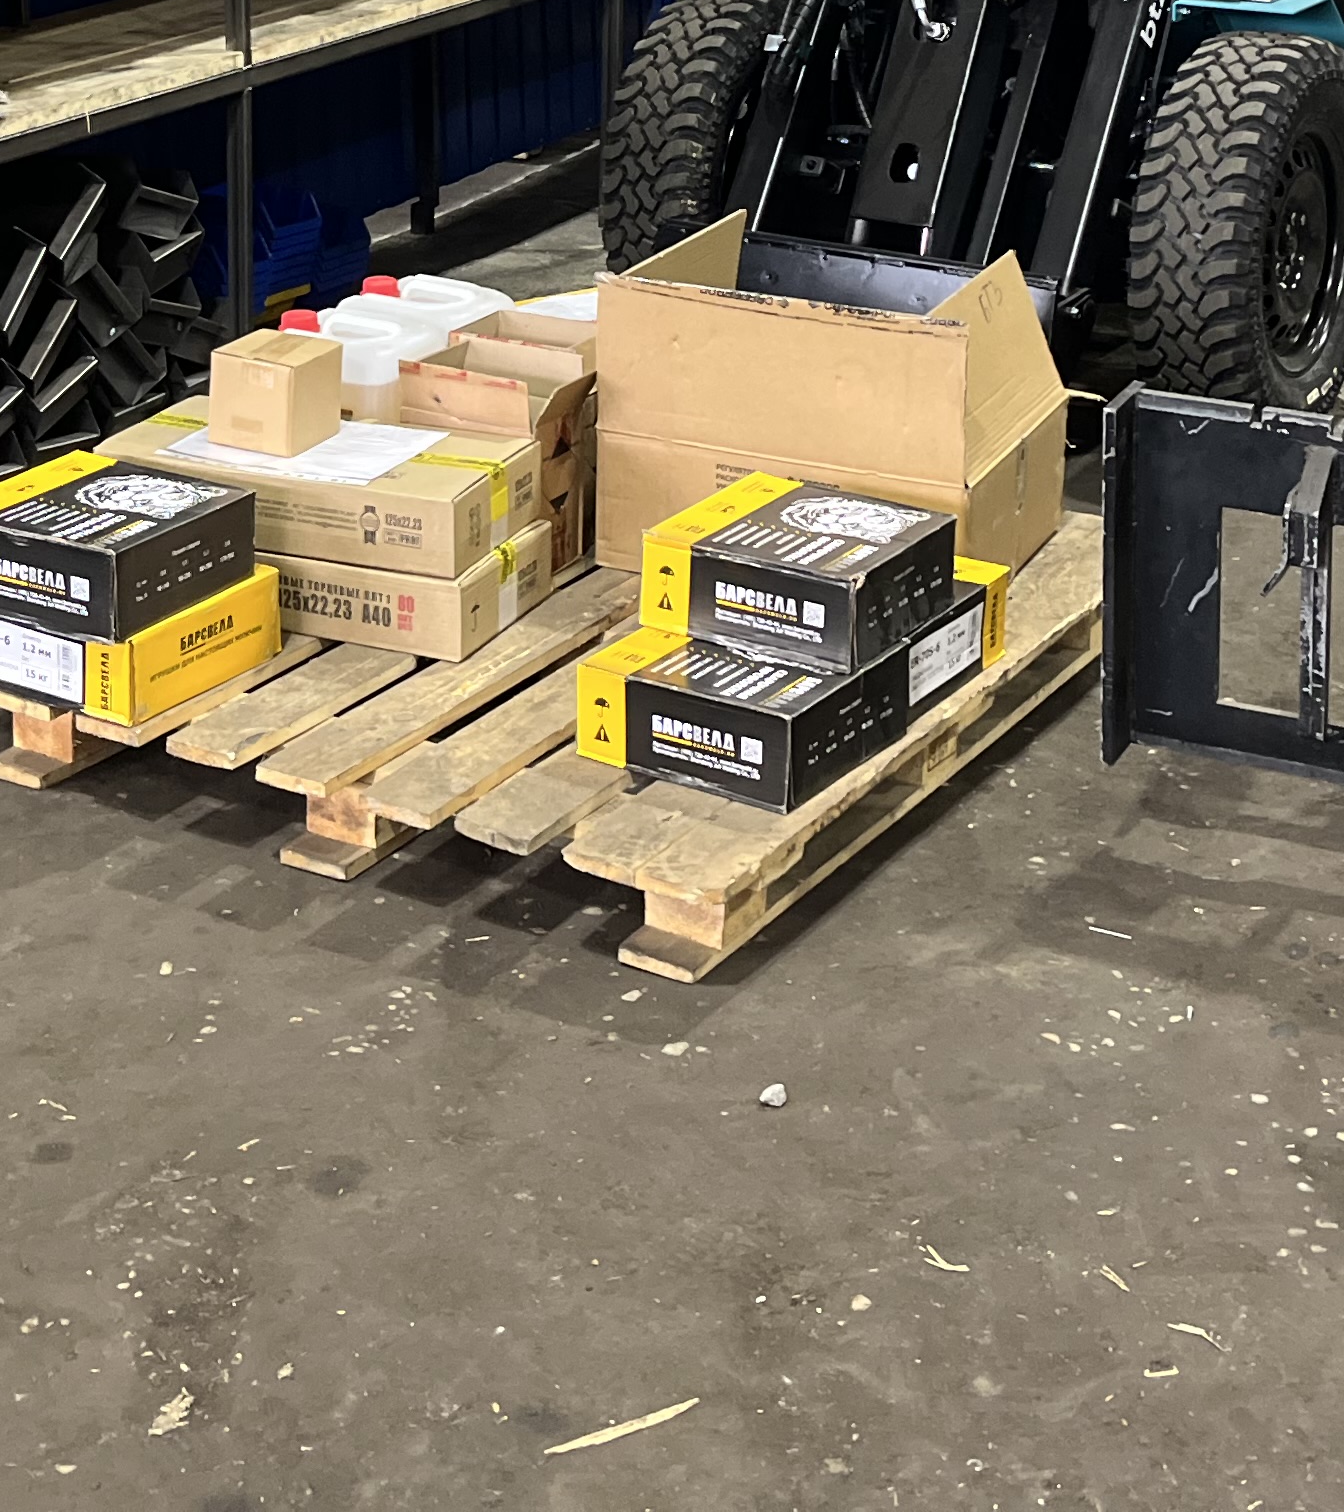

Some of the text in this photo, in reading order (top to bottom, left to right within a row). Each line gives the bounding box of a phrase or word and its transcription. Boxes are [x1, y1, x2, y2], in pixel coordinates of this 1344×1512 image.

[715, 580, 798, 616] БАРСВЕЛД
[180, 615, 234, 651] БАРСВЕЛД
[650, 713, 736, 751] БАРСВЕЛД
